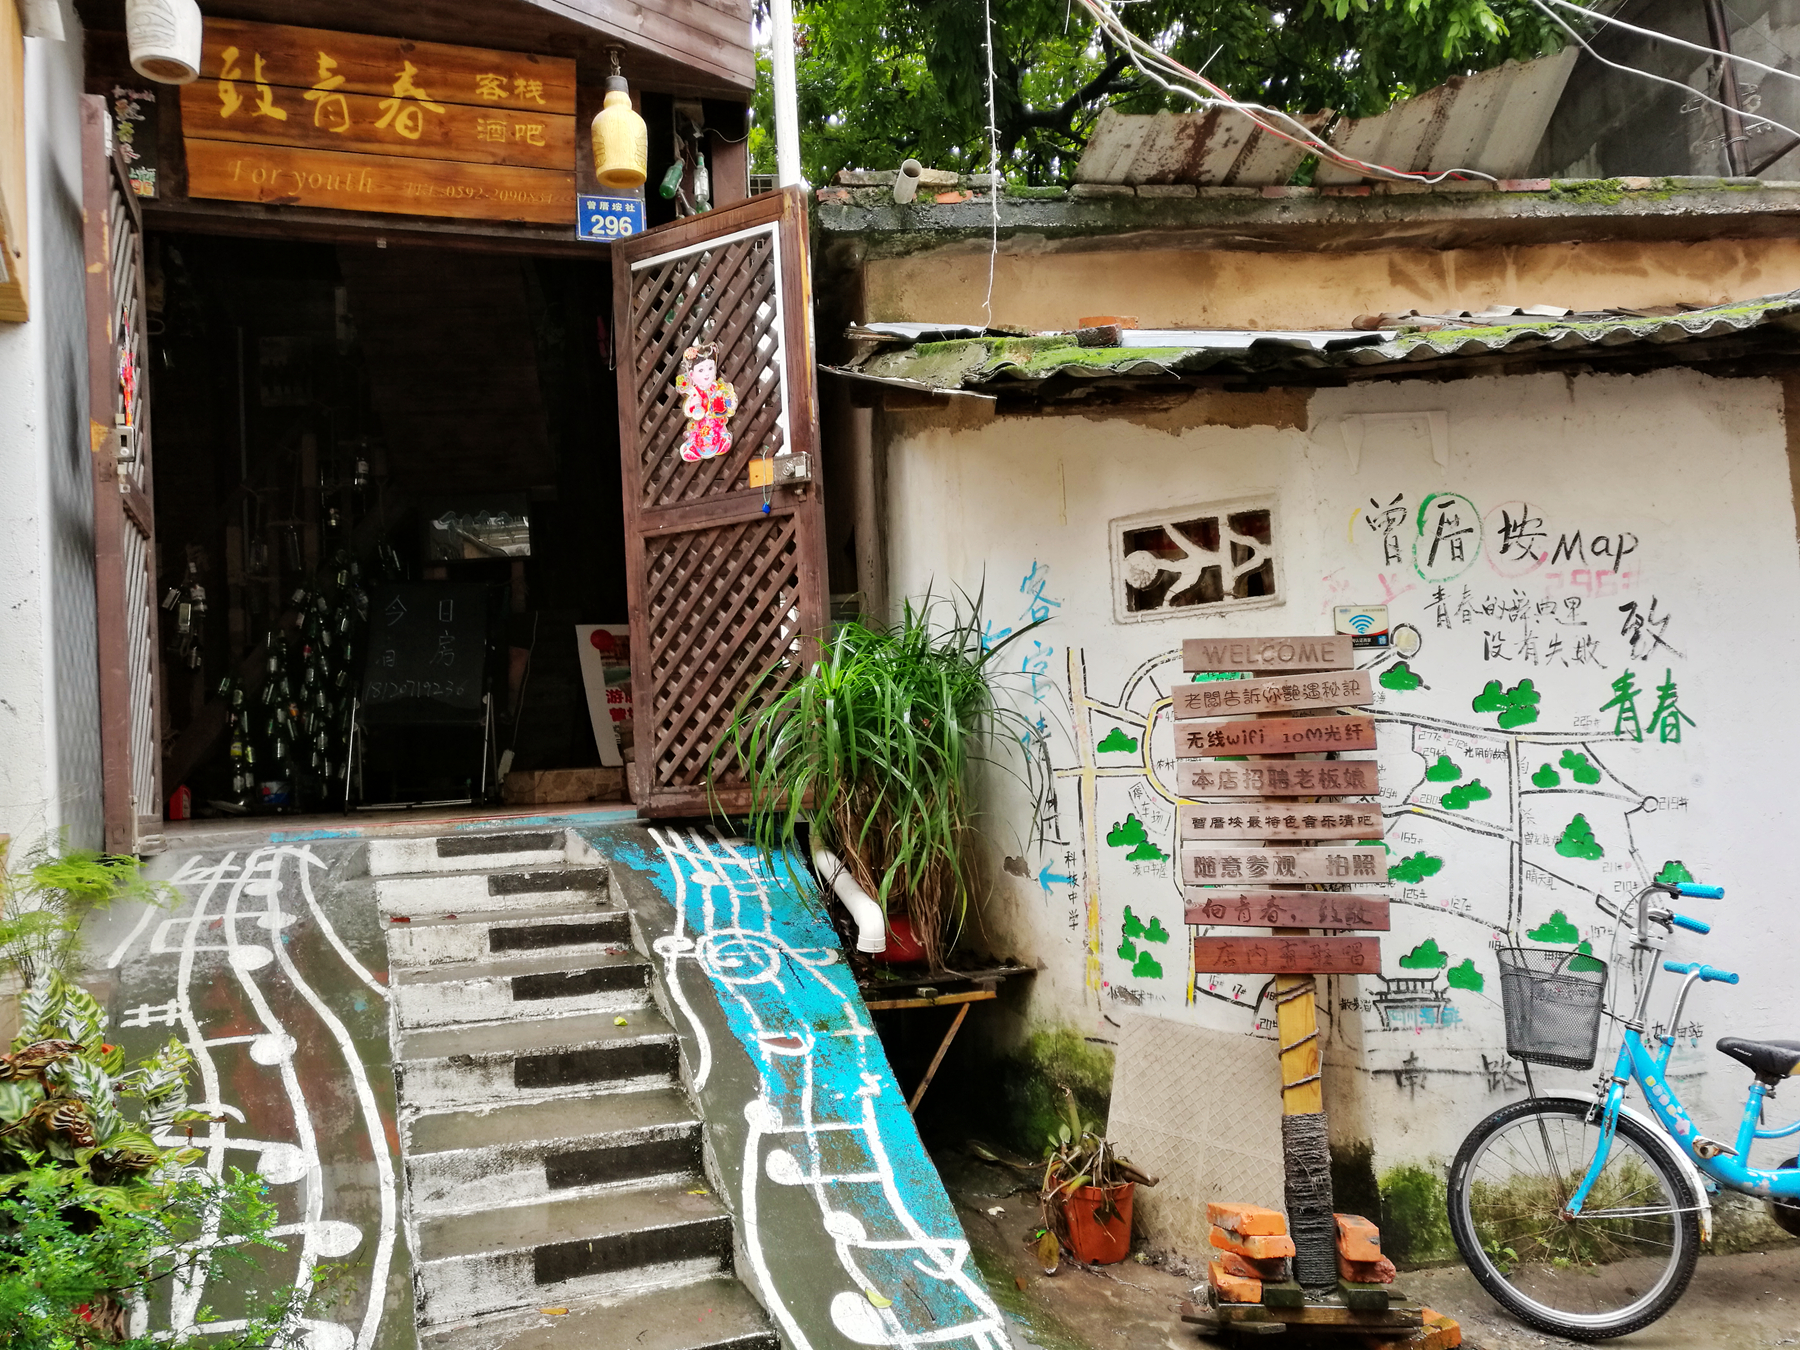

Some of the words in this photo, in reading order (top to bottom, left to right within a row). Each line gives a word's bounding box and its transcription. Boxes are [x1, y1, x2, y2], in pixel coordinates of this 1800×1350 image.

[218, 46, 446, 140] 致青春
[475, 73, 547, 105] 客栈
[476, 118, 547, 147] 酒吧
[228, 158, 283, 185] For
[288, 168, 373, 195] youth
[586, 200, 636, 212] 曾厝垵社
[591, 214, 633, 236] 296
[1366, 493, 1547, 567] 曾厝垵
[1551, 529, 1640, 573] Map
[1424, 585, 1588, 632] 青春的辞典里
[1619, 595, 1685, 662] 致
[1202, 643, 1336, 665] WELCOME
[1483, 627, 1608, 669] 没有失败
[1600, 668, 1697, 744] 青春
[1186, 729, 1265, 749] 无线wifi
[1282, 723, 1364, 744] 10M光纤
[1191, 767, 1368, 791] 本店招聘老板娘
[1132, 785, 1164, 825] 停车场
